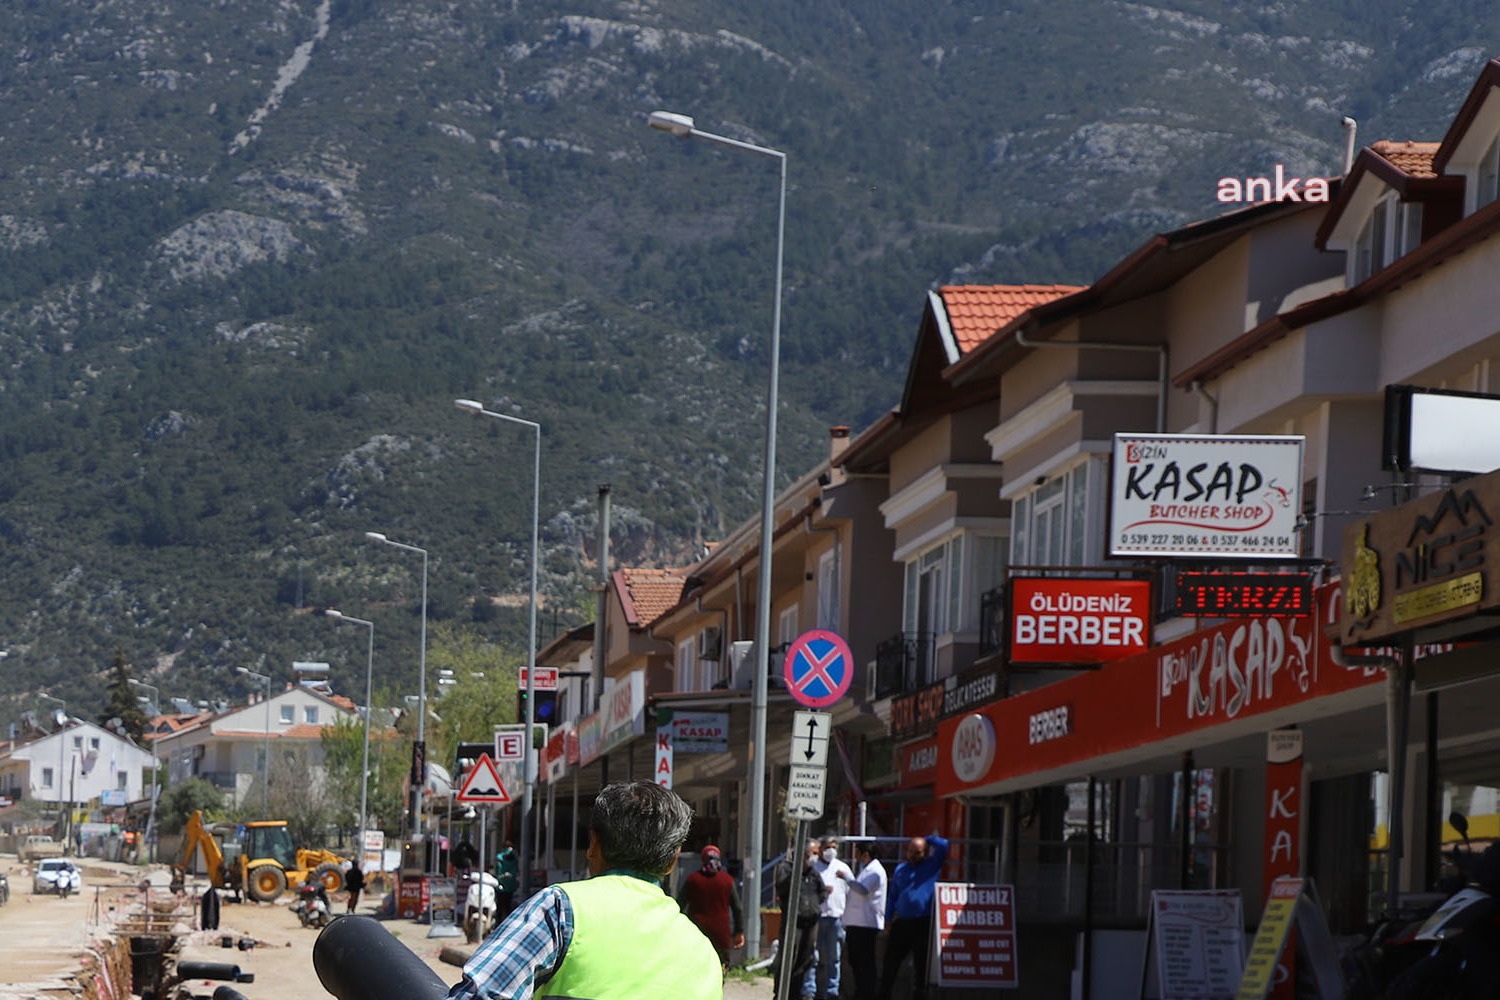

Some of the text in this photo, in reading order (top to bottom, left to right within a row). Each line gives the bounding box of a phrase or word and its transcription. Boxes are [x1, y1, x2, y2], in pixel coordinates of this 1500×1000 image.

[1125, 461, 1263, 504] KASAP
[1149, 504, 1263, 520] BUTCHER SHOP
[1121, 534, 1127, 544] 0
[1131, 534, 1148, 545] 539
[1151, 535, 1168, 545] 227
[1187, 535, 1199, 545] 06
[1212, 535, 1218, 545] 0
[1220, 535, 1238, 546] 537
[1278, 536, 1289, 546] 04
[1030, 592, 1132, 613] ÖLÜDENİZ
[1016, 615, 1144, 646] BERBER
[1187, 617, 1285, 720] KASAP
[679, 728, 722, 737] KASAP
[1029, 705, 1069, 746] BERBER
[503, 738, 517, 755] E
[940, 887, 1010, 906] ÖLÜDENİZ
[946, 909, 1005, 926] BARBER
